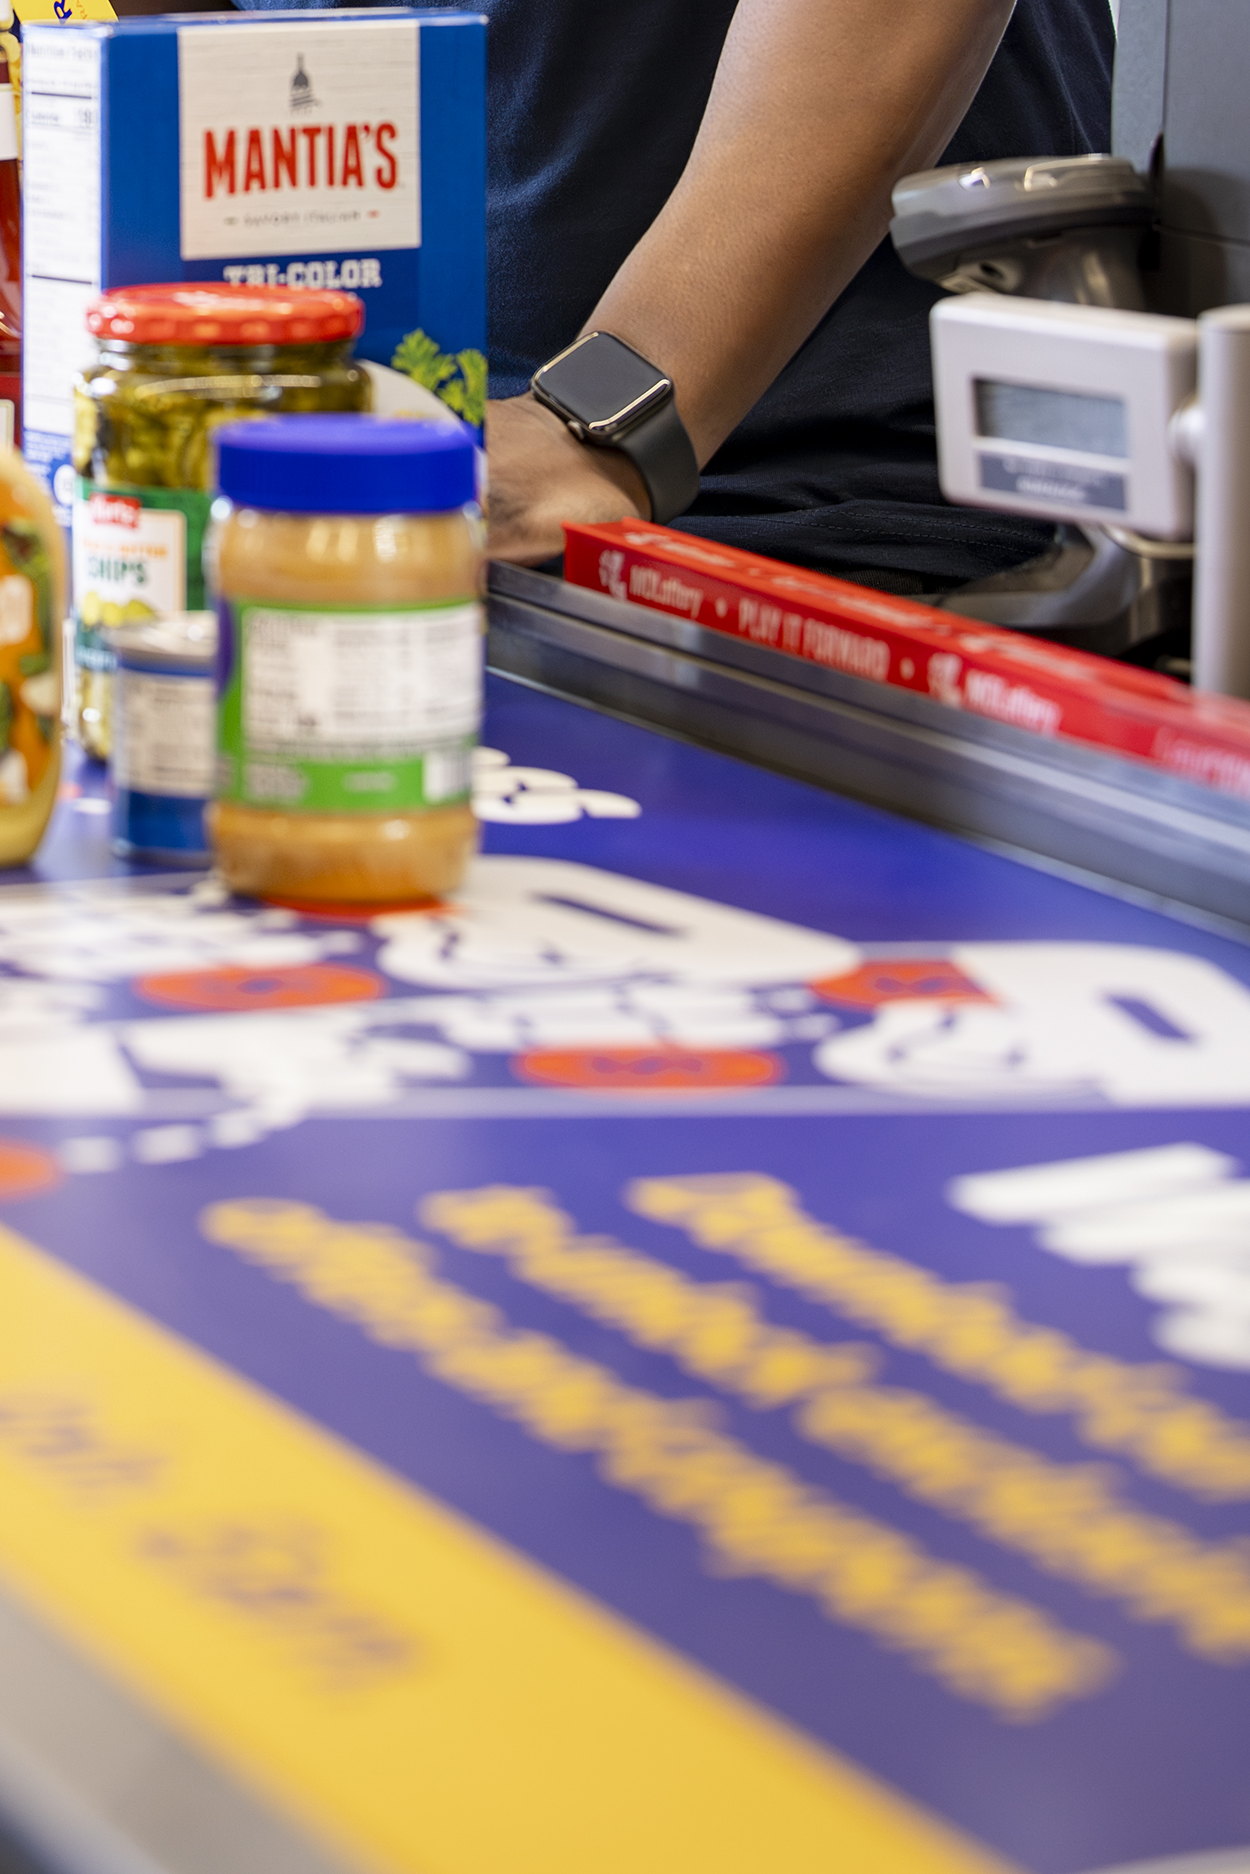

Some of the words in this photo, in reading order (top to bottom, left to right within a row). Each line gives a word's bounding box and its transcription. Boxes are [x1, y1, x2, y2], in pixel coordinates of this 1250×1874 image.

[204, 122, 398, 199] MANTIA'S
[222, 257, 384, 290] TRI-COLOR
[88, 556, 146, 587] CHIPS
